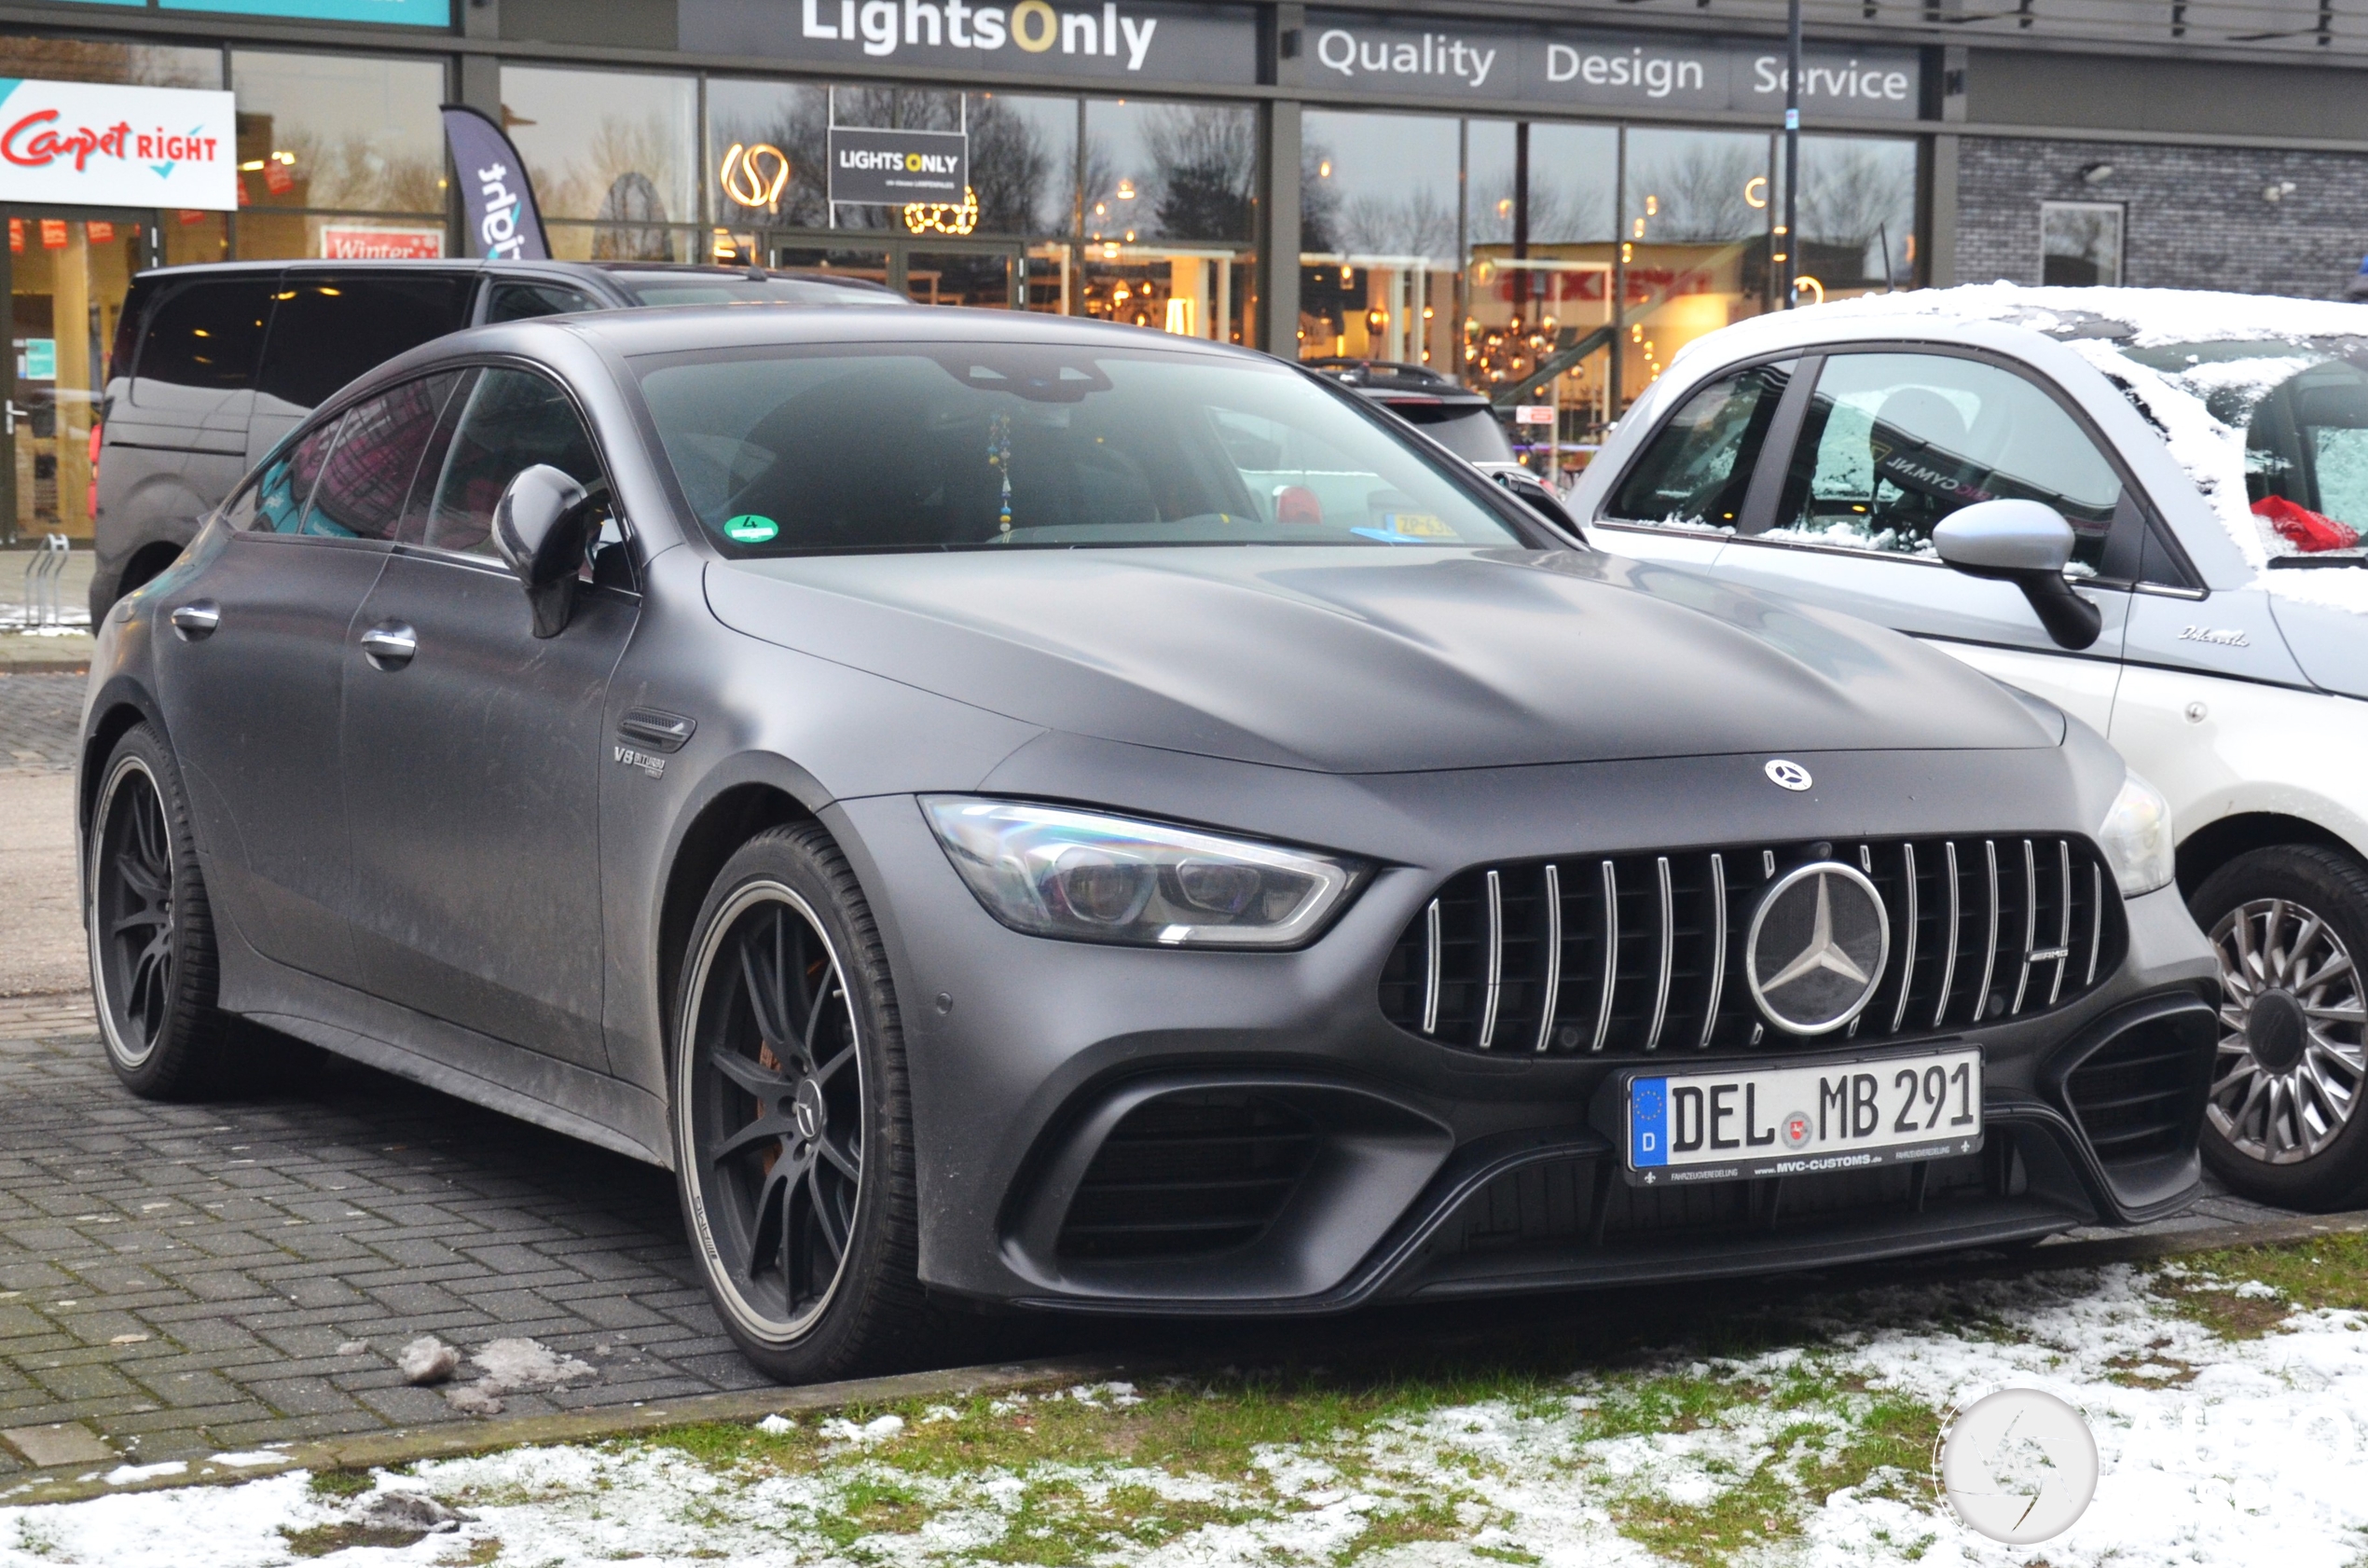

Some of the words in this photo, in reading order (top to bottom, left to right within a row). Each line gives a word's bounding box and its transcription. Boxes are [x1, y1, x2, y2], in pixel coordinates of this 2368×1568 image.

[803, 0, 1157, 71] LightsOnly
[1317, 29, 1495, 87] Quality
[1547, 44, 1703, 97] Design
[1754, 56, 1908, 100] Service
[0, 109, 132, 172] Carpet
[839, 149, 903, 172] LIGHTS
[905, 153, 958, 174] ONLY
[334, 239, 416, 259] Winter
[742, 516, 758, 529] 4
[613, 747, 634, 764] V8
[1642, 1132, 1656, 1152] D
[1673, 1082, 1775, 1153] DEL
[1819, 1073, 1879, 1141] MB
[1893, 1062, 1975, 1134] 291
